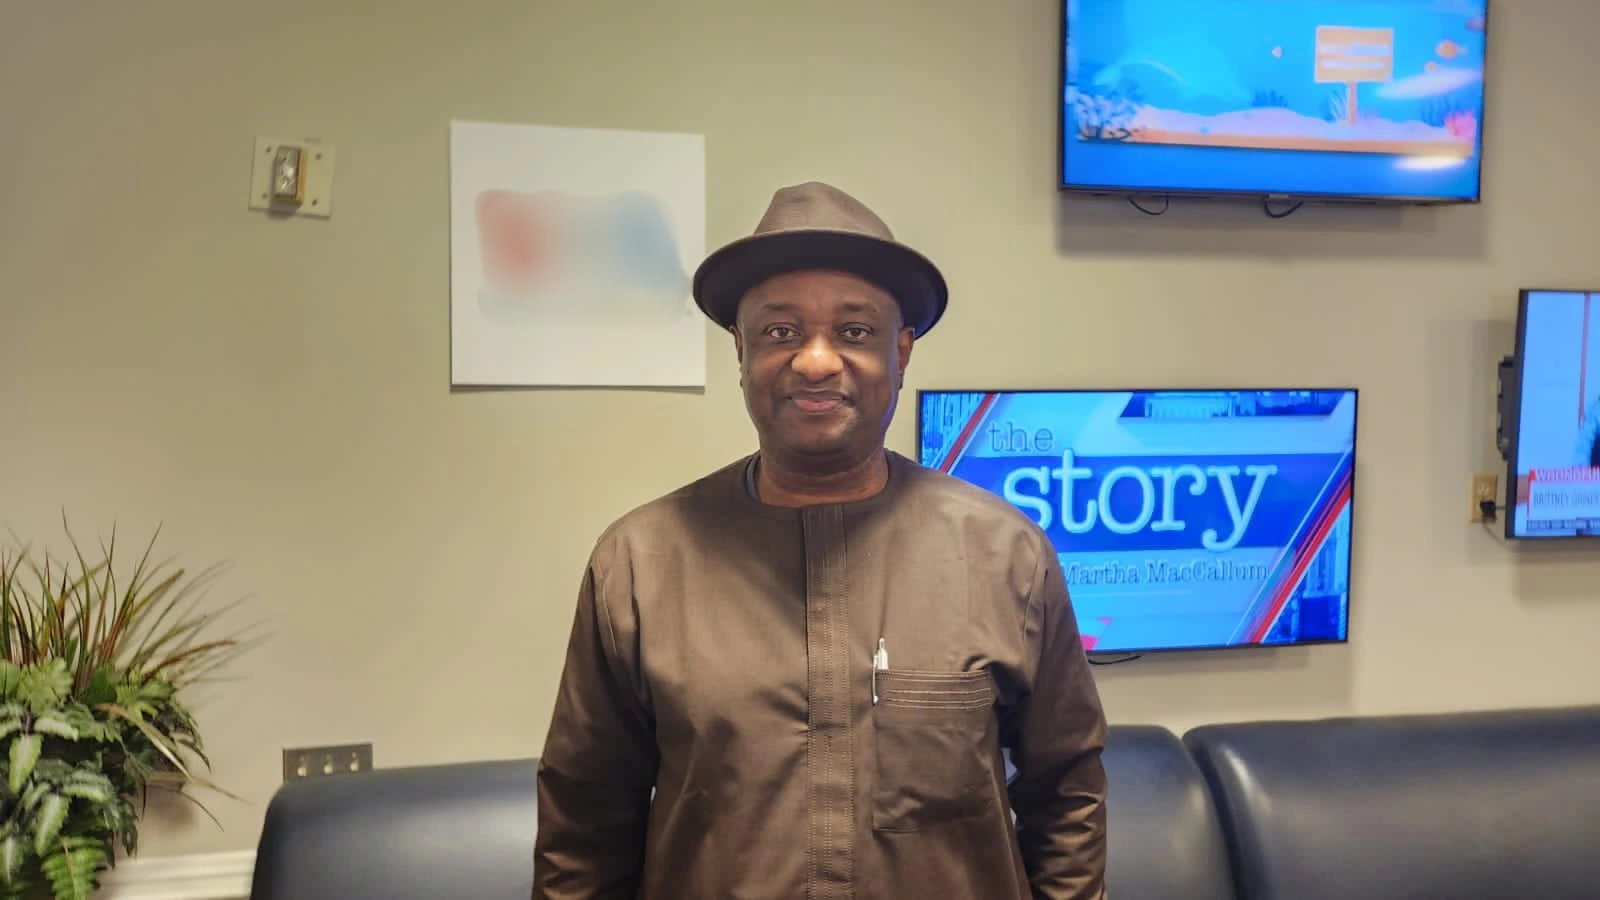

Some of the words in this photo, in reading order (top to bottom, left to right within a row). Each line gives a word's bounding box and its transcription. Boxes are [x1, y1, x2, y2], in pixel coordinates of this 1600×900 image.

[989, 421, 1054, 452] the
[1003, 448, 1278, 552] story
[1064, 561, 1140, 585] Martha
[1145, 559, 1270, 583] MacCallum
